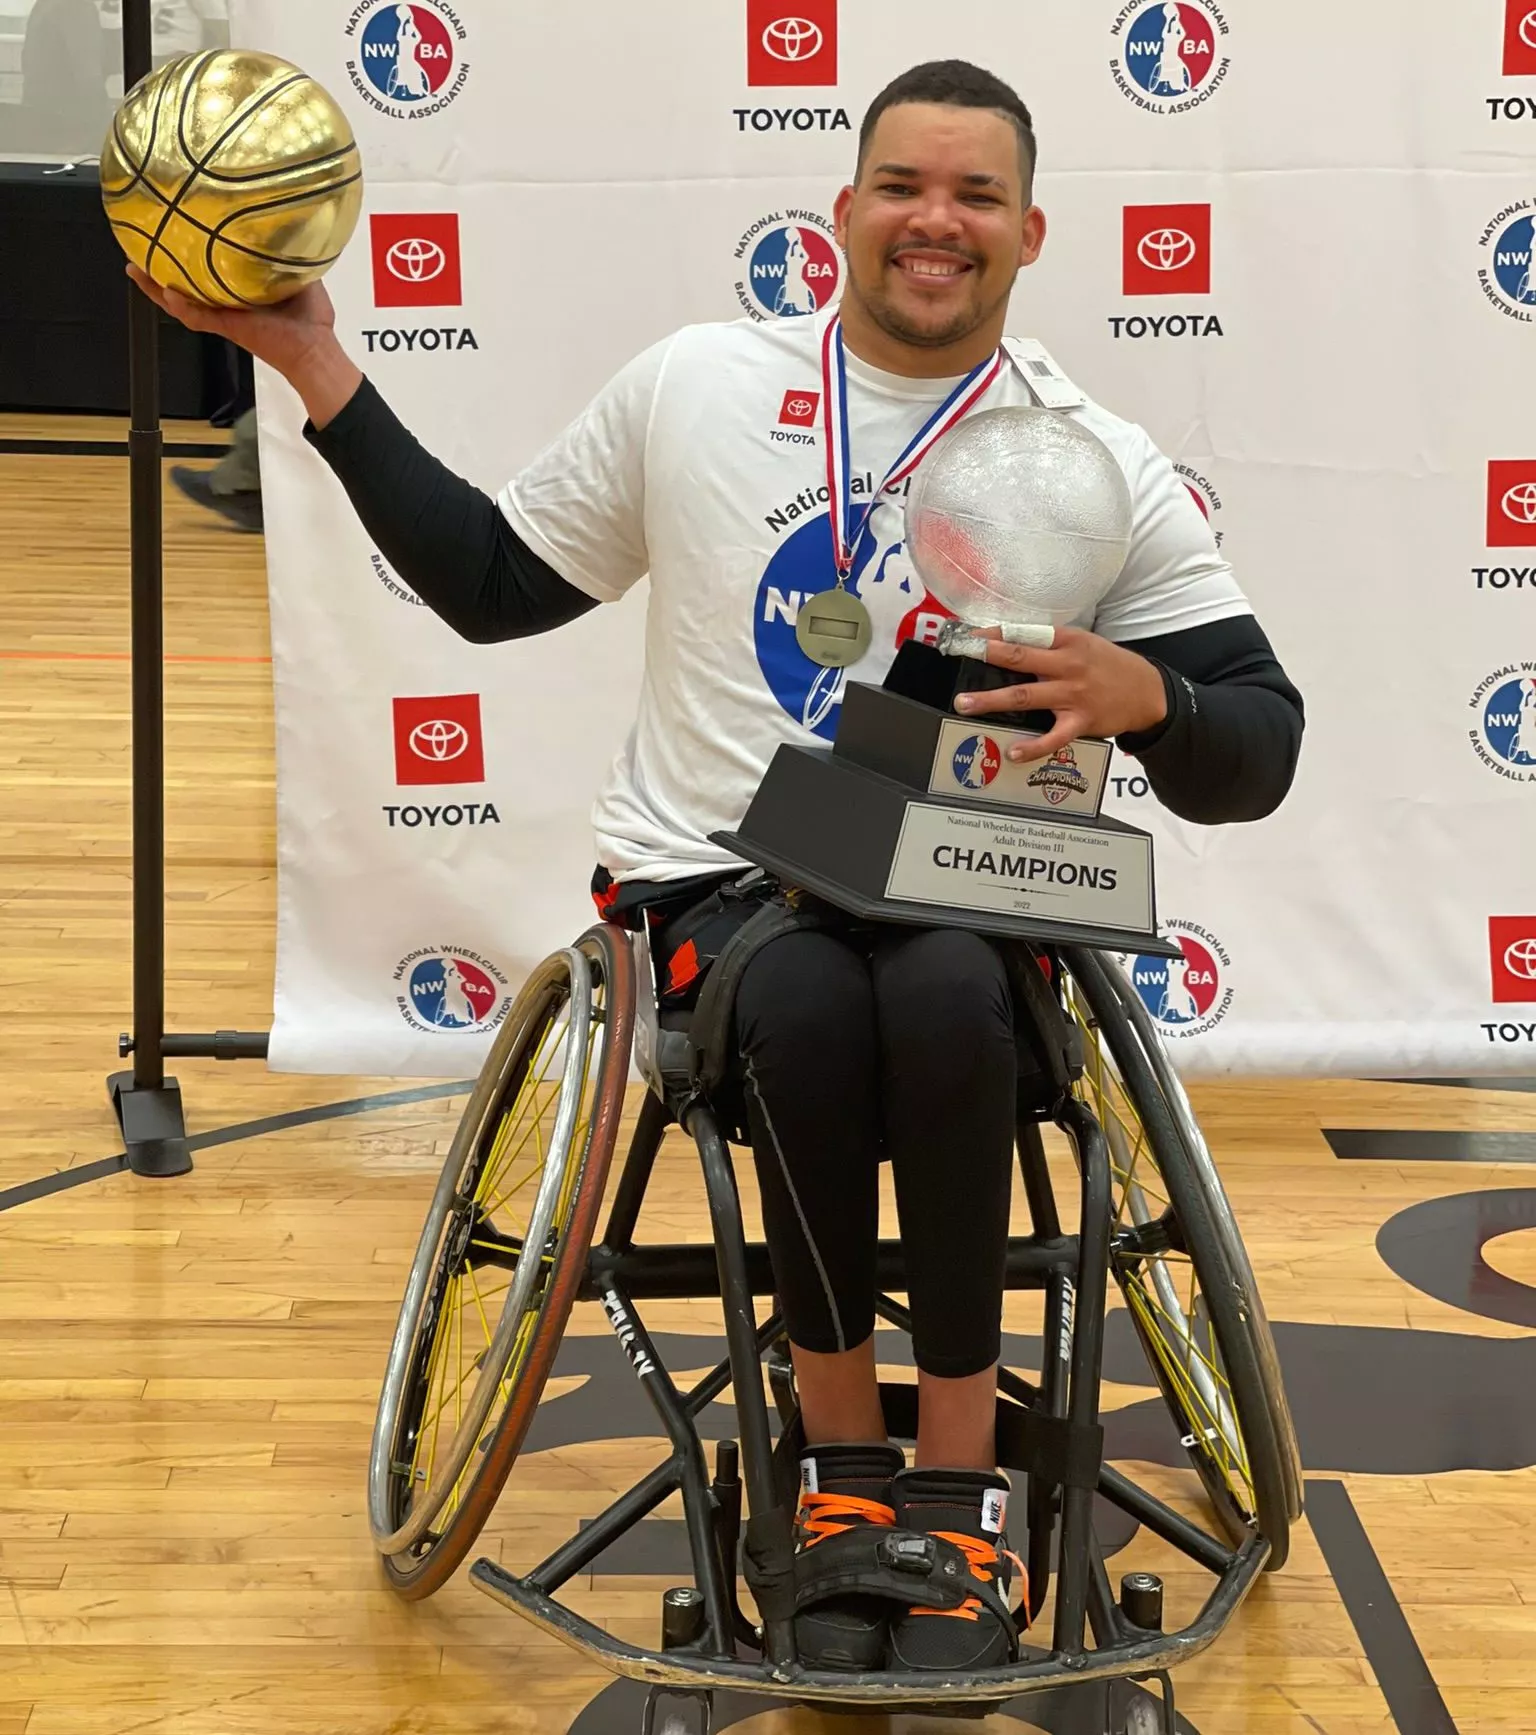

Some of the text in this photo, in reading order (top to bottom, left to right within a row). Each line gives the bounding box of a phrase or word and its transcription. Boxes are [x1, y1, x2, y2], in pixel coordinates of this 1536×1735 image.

[364, 43, 448, 59] NW BA
[1129, 39, 1210, 56] NW BA
[346, 60, 470, 120] BASKETBALL ASSOCIATION
[1109, 57, 1231, 115] BASKETBALL ASSOCIATION
[732, 108, 852, 131] TOYOTA
[733, 209, 838, 259] NATIONAL WHEELC
[1478, 199, 1530, 246] NATIONAL
[753, 263, 834, 278] NW BA
[1497, 252, 1529, 266] NW
[1477, 269, 1533, 322] BASKETBALL
[1107, 315, 1224, 339] TOYOTA
[361, 328, 479, 353] TOYOTA
[769, 430, 816, 446] TOYOTA
[764, 471, 873, 534] Natioal
[1468, 664, 1518, 709] NATIONAL
[1487, 713, 1519, 727] NW
[954, 753, 998, 769] NW BA
[1468, 729, 1525, 782] BASKETBALL
[1026, 770, 1090, 791] CHAMPIONSHIP
[382, 803, 500, 827] TOYOTA
[947, 815, 1109, 847] National Wheelchair Basketball Association
[992, 835, 1065, 854] Adult Division III
[932, 845, 1117, 891] CHAMPIONS
[1013, 901, 1032, 910] 2022
[1165, 919, 1231, 967] WHEELCHAIR
[393, 945, 509, 985] NATIONAL WHEELCHAIR
[413, 980, 491, 996] NW BA
[1136, 970, 1214, 985] NW BA
[1179, 987, 1235, 1038] ASSOCIATION
[1480, 1023, 1536, 1043] TOY
